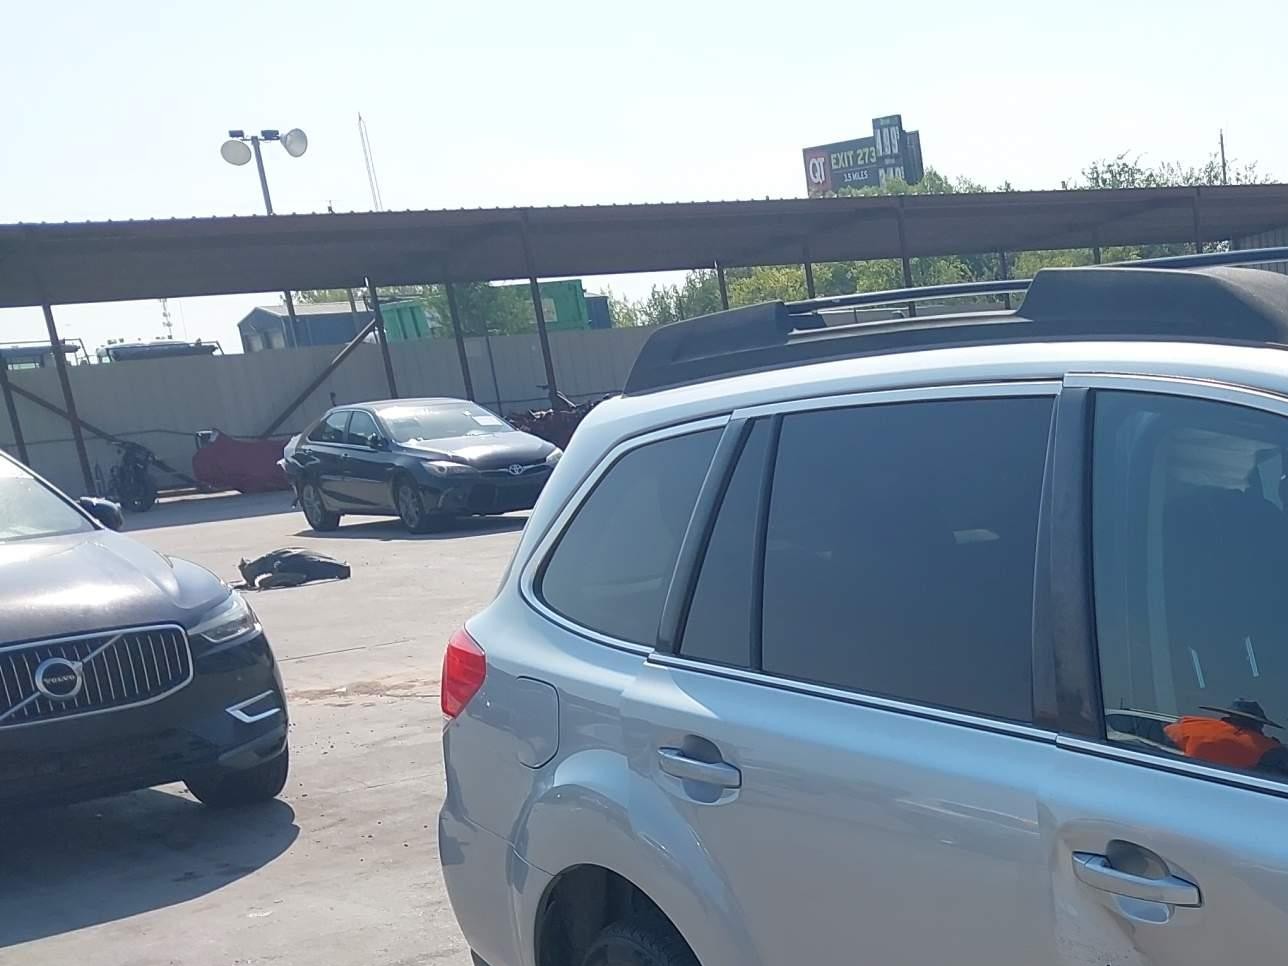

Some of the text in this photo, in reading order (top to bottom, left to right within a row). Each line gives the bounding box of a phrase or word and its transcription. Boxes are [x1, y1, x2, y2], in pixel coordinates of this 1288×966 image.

[830, 150, 854, 169] EXIT
[857, 147, 877, 165] 273
[809, 157, 825, 184] QT
[852, 170, 868, 181] MILES
[43, 674, 75, 685] VOLVO
